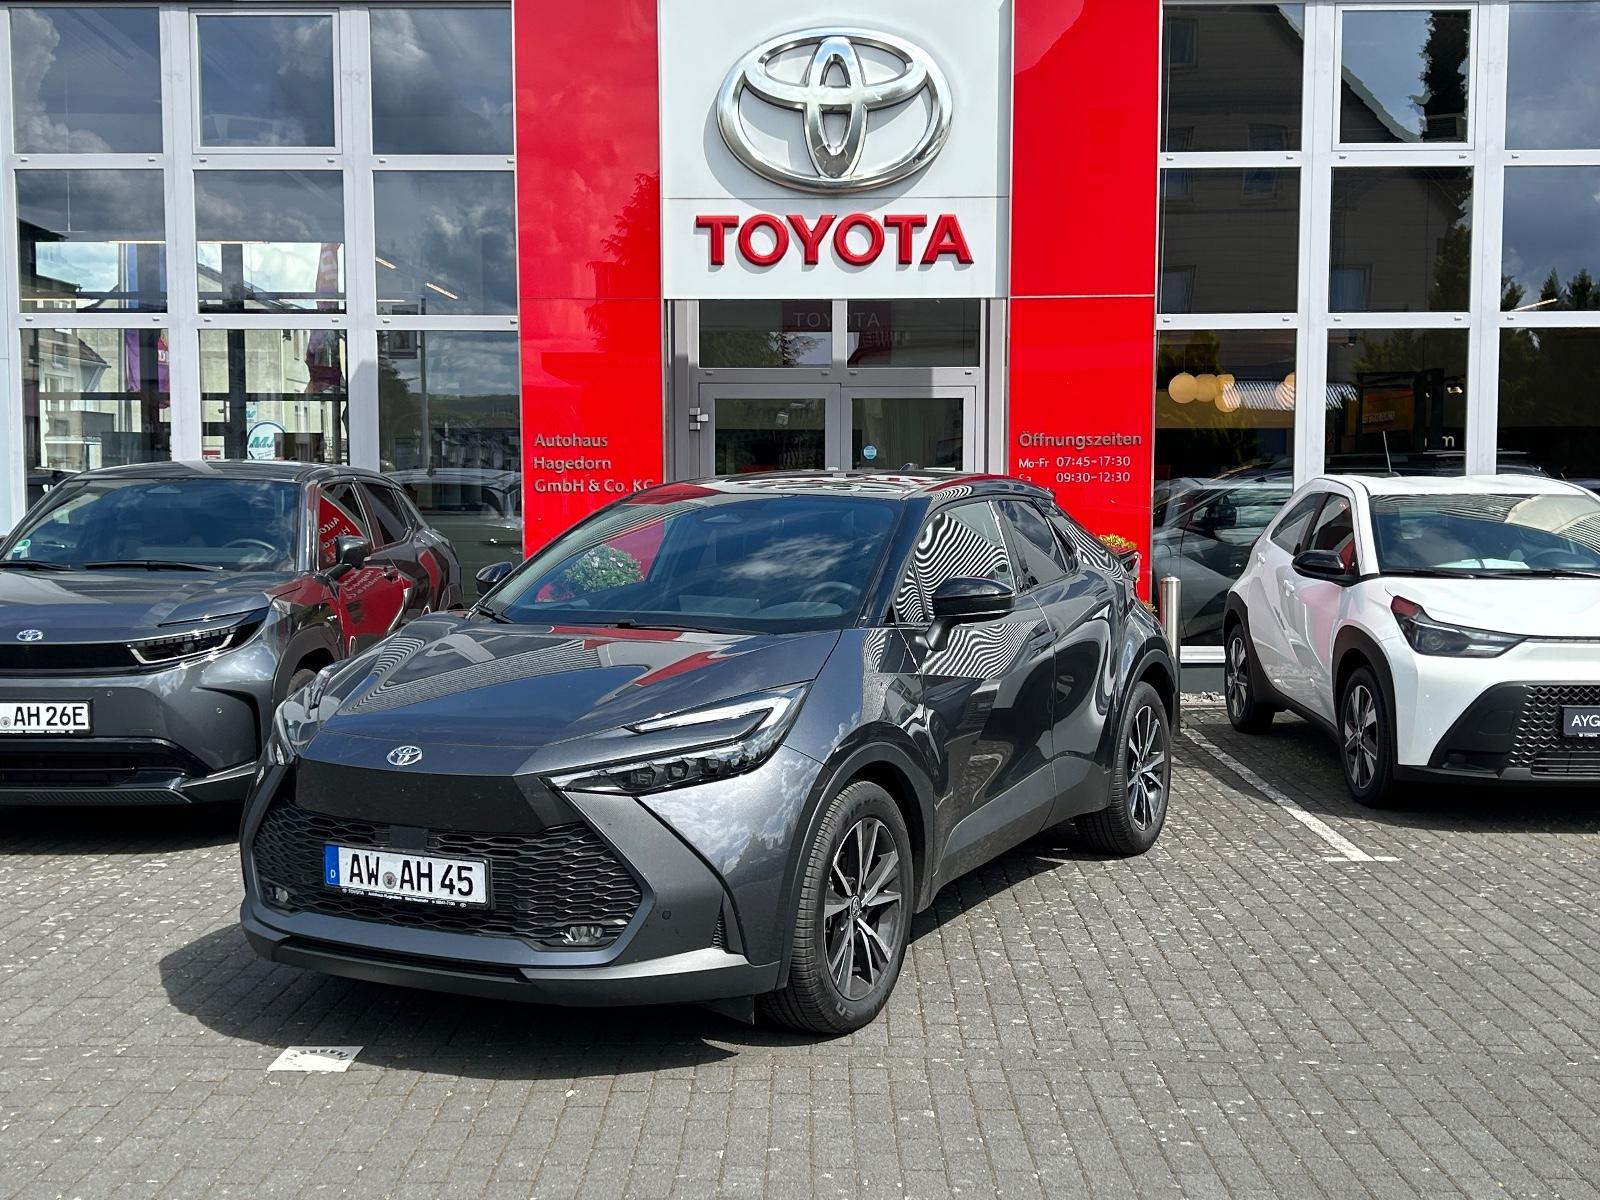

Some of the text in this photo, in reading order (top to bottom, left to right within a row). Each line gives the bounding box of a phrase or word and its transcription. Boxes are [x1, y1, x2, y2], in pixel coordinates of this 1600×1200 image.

[695, 213, 975, 267] TOYOTA
[792, 312, 881, 328] TOYTA
[534, 432, 609, 447] Autohaus
[1019, 430, 1142, 450] Öffnungszeiten
[533, 455, 612, 474] Hagedorn
[1018, 455, 1131, 469] Mo-Fr 07:45-17:30
[534, 478, 585, 493] GmbH
[588, 479, 601, 493] &
[603, 479, 630, 493] Co.
[1056, 471, 1131, 483] 09:30-12:30
[14, 706, 86, 726] AH 26E
[330, 853, 474, 897] D AW AH 45
